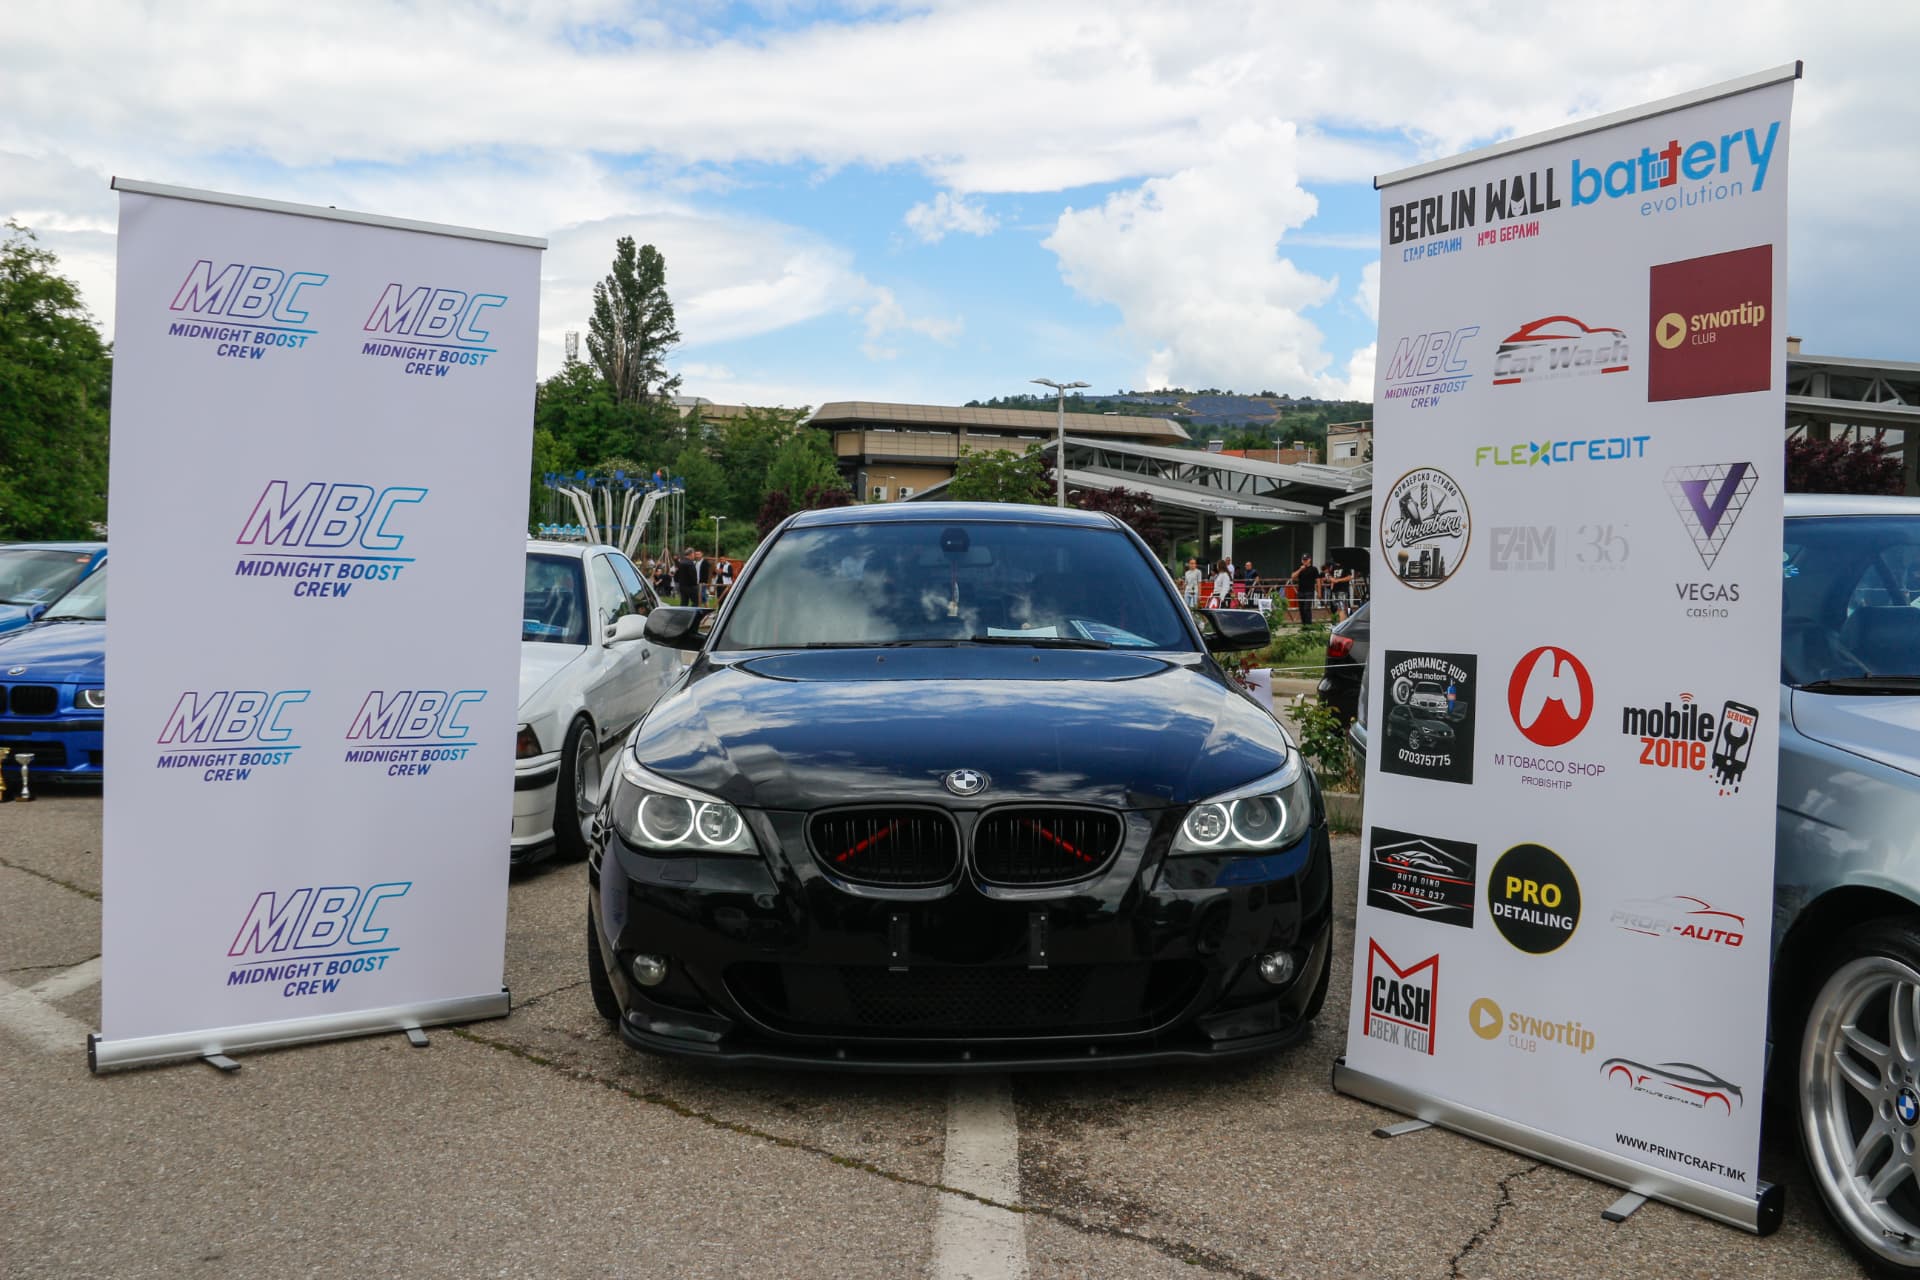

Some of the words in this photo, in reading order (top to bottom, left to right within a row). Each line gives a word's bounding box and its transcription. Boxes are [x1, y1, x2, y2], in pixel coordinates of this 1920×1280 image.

[1571, 121, 1781, 207] battery
[1389, 187, 1475, 245] BERLIN
[1485, 168, 1561, 224] WALL
[1640, 181, 1742, 216] evolution
[169, 259, 329, 324] MBC
[363, 283, 508, 343] MBC
[168, 322, 252, 344] MIDNIGHT
[254, 330, 308, 349] BOOST
[1691, 332, 1716, 345] CLUB
[216, 343, 266, 360] CREW
[361, 342, 436, 362] MIDNIGHT
[438, 349, 488, 367] BOOST
[1385, 326, 1480, 380] MBC
[1494, 353, 1542, 376] Car
[1549, 340, 1629, 370] Wash
[404, 361, 450, 377] CREW
[1385, 384, 1432, 399] MIDNIGHT
[1432, 381, 1467, 394] BOOST
[1411, 396, 1440, 408] CREW
[236, 479, 429, 550] MBC
[235, 559, 334, 579] MIDNIGHT
[336, 563, 404, 581] BOOST
[293, 581, 352, 598] CREW
[1675, 583, 1740, 602] VEGAS
[1686, 604, 1729, 618] casino
[1390, 657, 1448, 680] PERFORMANCE
[1447, 664, 1468, 683] HUB
[1424, 672, 1447, 681] motors
[157, 689, 311, 744] MBC
[345, 689, 488, 740] MBC
[1623, 702, 1715, 742] mobile
[1726, 710, 1754, 727] SERVICE
[156, 753, 237, 769] MIDNIGHT
[239, 751, 293, 766] BOOST
[344, 749, 418, 763] MIDNIGHT
[419, 748, 469, 761] BOOST
[1398, 748, 1451, 767] 070375775
[1494, 753, 1505, 766] M
[1506, 754, 1565, 773] TOBACCO
[1567, 762, 1606, 777] SHOP
[1639, 737, 1706, 771] zone
[203, 768, 252, 782] CREW
[387, 763, 432, 777] CREW
[1521, 776, 1573, 790] PROBISHTIP
[1391, 882, 1407, 892] 077
[1505, 876, 1562, 908] PRO
[227, 881, 412, 957] MBC
[1493, 902, 1573, 930] DETAILING
[227, 961, 323, 986] MIDNIGHT
[325, 955, 389, 976] BOOST
[283, 978, 341, 998] CREW
[1371, 975, 1431, 1025] CASH
[1370, 1018, 1400, 1045] СВЕЖ
[1404, 1028, 1428, 1054] КЕШ
[1508, 1034, 1537, 1053] CLUB
[1615, 1132, 1747, 1182] WWW.PRINTCRAFT.MK
